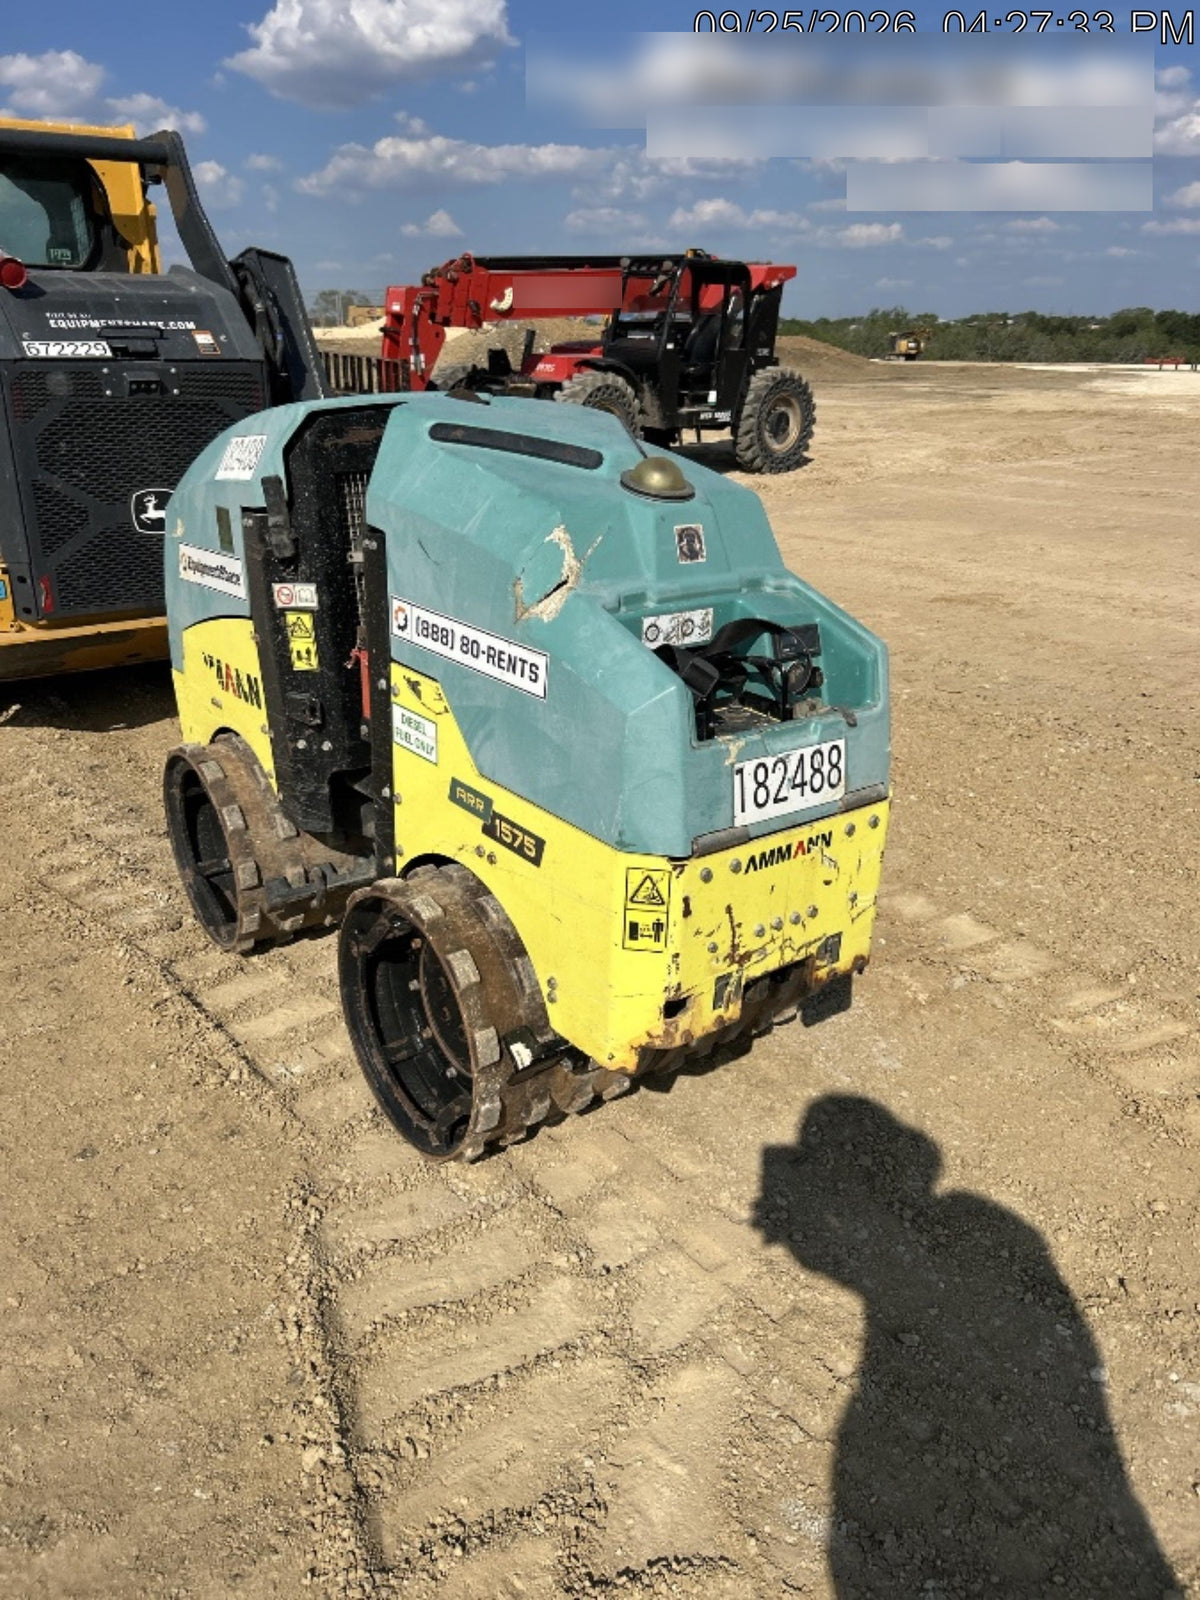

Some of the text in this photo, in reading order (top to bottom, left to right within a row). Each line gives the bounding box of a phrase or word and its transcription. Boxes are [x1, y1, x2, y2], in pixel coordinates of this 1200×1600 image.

[415, 616, 540, 684] (888) 80-RENTS
[401, 712, 427, 737] DIESEL
[735, 744, 842, 813] 182488
[456, 786, 485, 813] ARR
[495, 819, 536, 858] 1575
